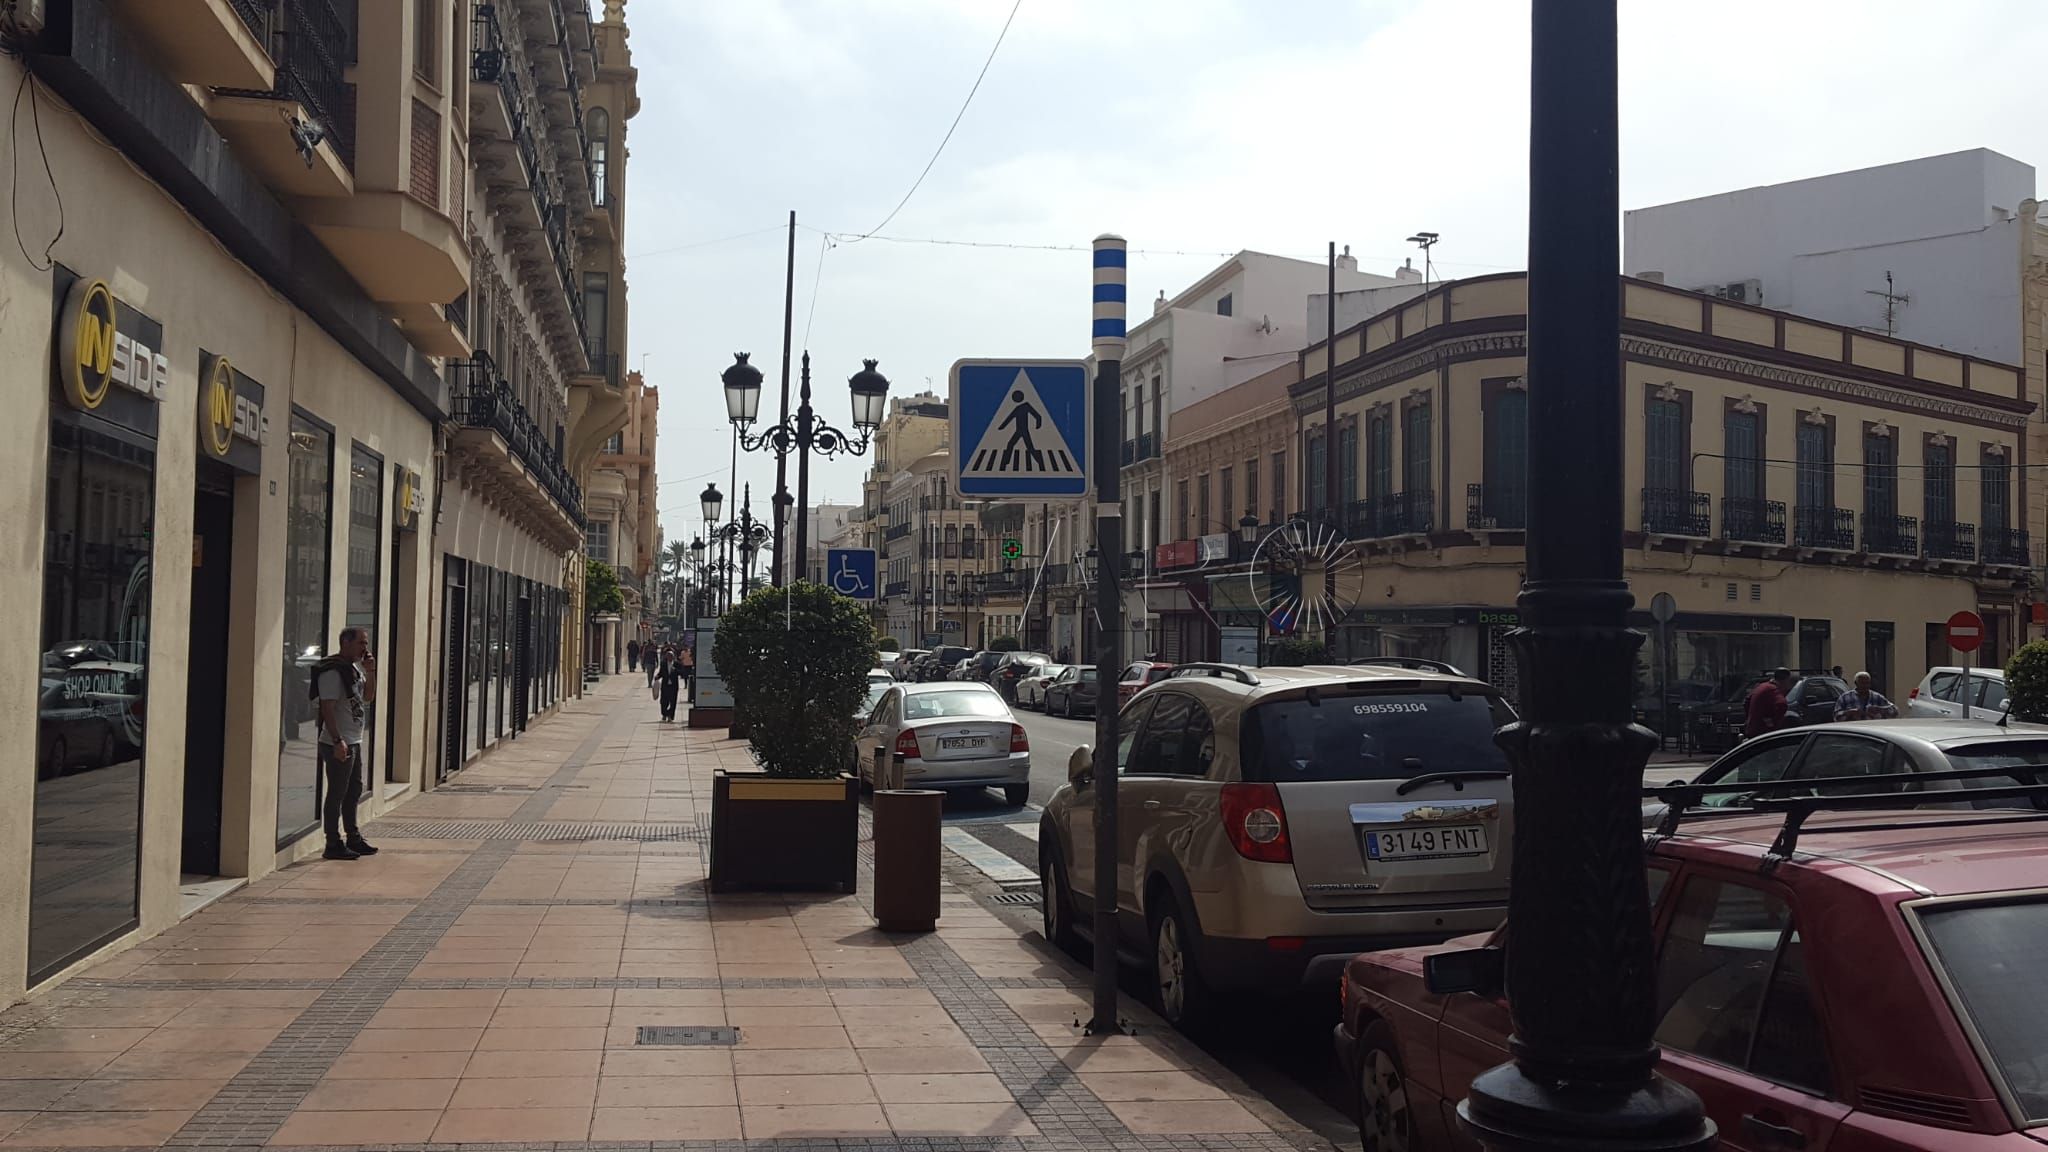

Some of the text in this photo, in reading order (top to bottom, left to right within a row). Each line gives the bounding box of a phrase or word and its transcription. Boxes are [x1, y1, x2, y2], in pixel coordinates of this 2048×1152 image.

[1479, 611, 1518, 624] base
[64, 672, 125, 700] SHOP ONLINE
[1353, 703, 1428, 715] 698559104
[1381, 831, 1436, 853] 3149
[1441, 828, 1480, 850] FNT
